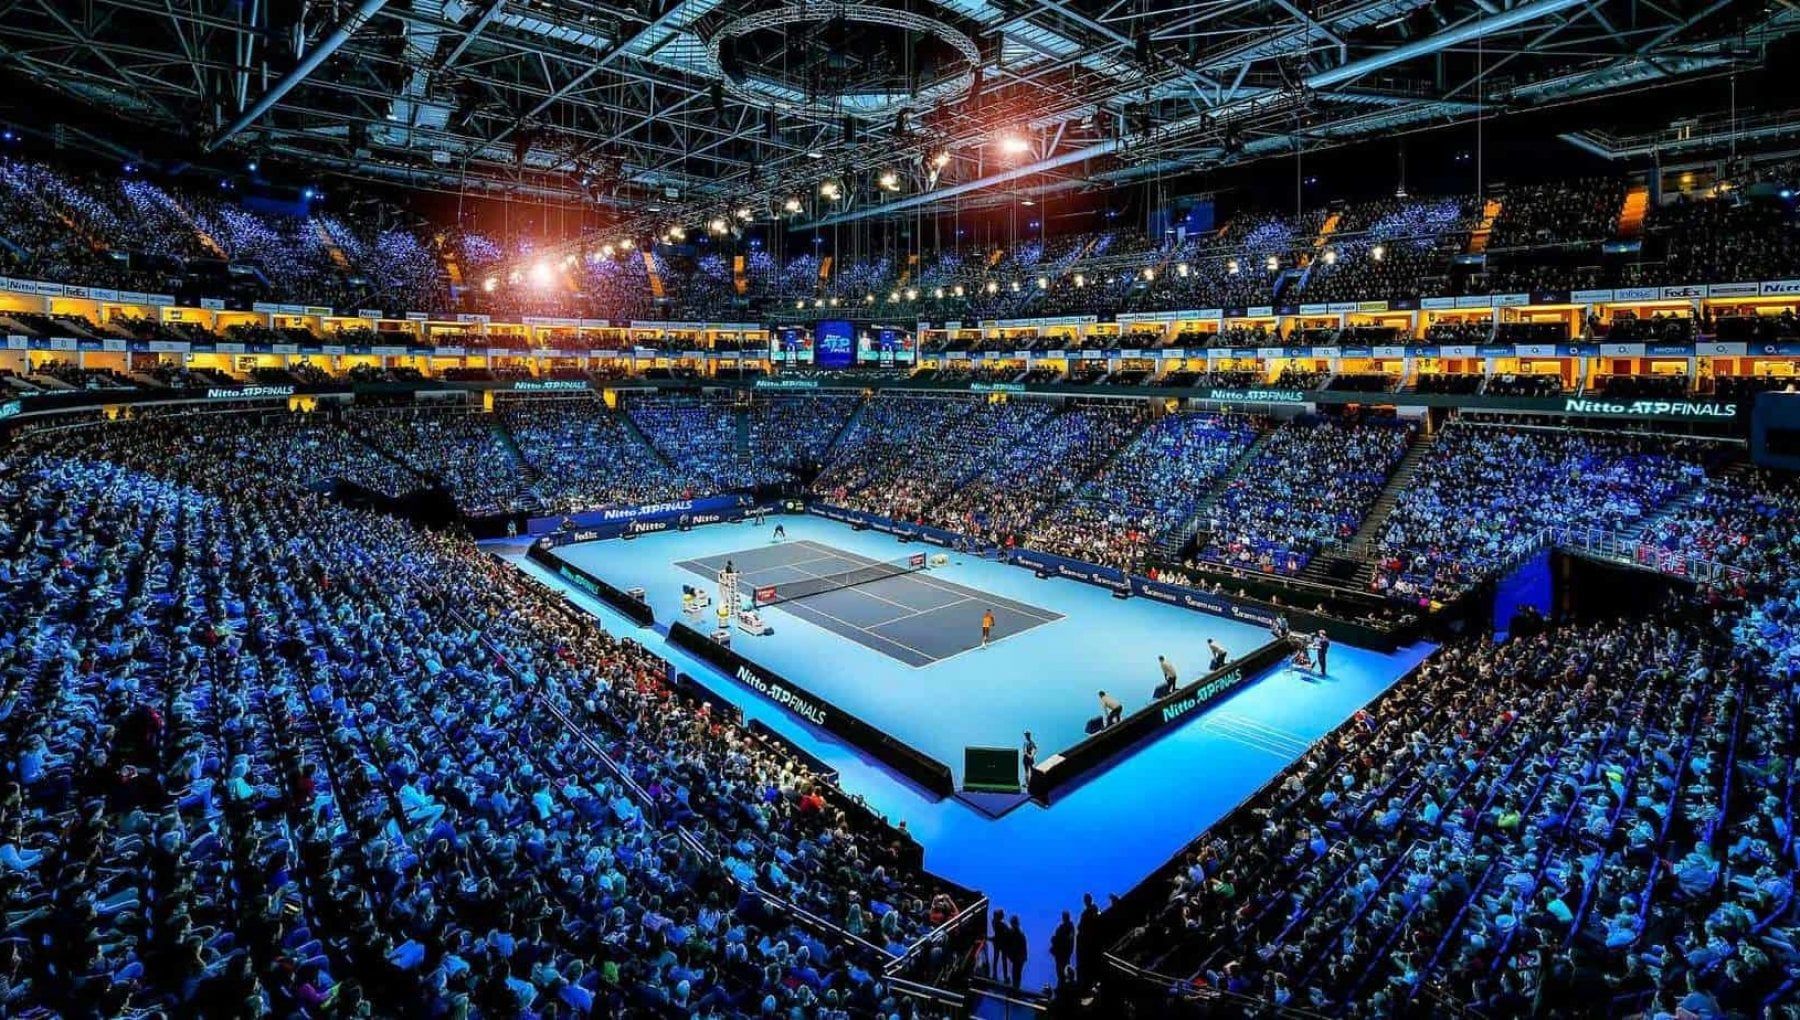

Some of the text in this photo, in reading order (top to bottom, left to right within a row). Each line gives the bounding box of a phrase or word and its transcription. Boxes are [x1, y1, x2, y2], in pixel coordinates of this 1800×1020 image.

[1665, 287, 1701, 297] FedEx
[1764, 284, 1800, 292] Nitt
[207, 388, 240, 398] Nitto
[1211, 389, 1243, 400] Nitto
[1565, 399, 1625, 413] Nitto
[604, 508, 637, 520] Nitto
[692, 513, 720, 525] Nitto
[635, 521, 667, 533] Nitto
[736, 665, 768, 692] Nitto
[1162, 698, 1196, 723] Nitto
